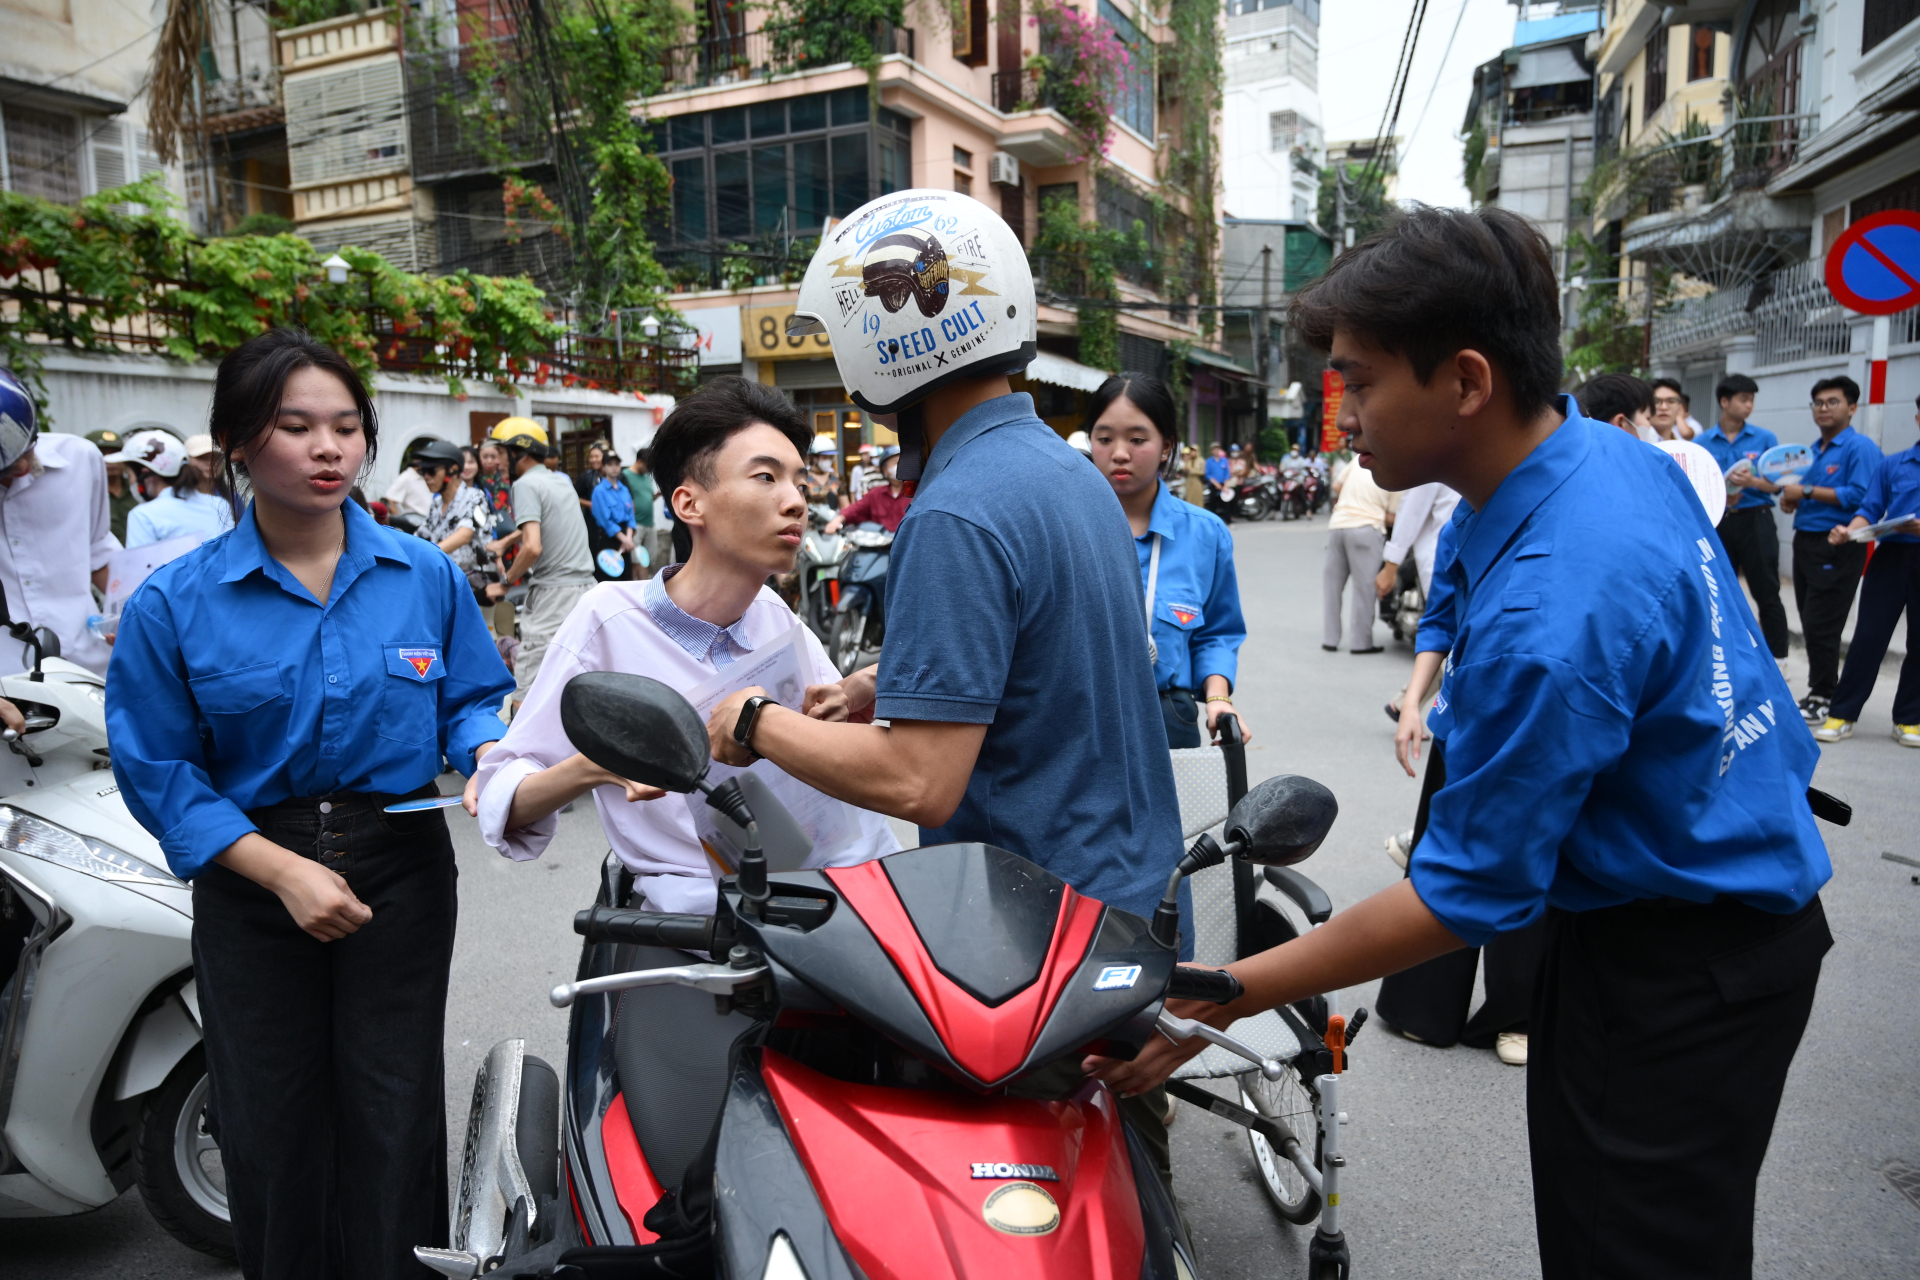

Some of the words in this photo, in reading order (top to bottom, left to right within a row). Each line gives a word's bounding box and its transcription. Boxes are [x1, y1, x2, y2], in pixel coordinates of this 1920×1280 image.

[855, 202, 933, 250] Custom
[934, 213, 957, 235] 62
[957, 234, 986, 260] FIRE
[835, 288, 861, 318] HELL
[862, 309, 881, 339] 19
[876, 327, 937, 365] SPEED
[940, 300, 986, 343] CULT
[891, 360, 933, 378] ORIGINAL
[950, 332, 986, 359] GENUINE
[1101, 968, 1136, 982] FI
[970, 1162, 1060, 1182] HONDA
